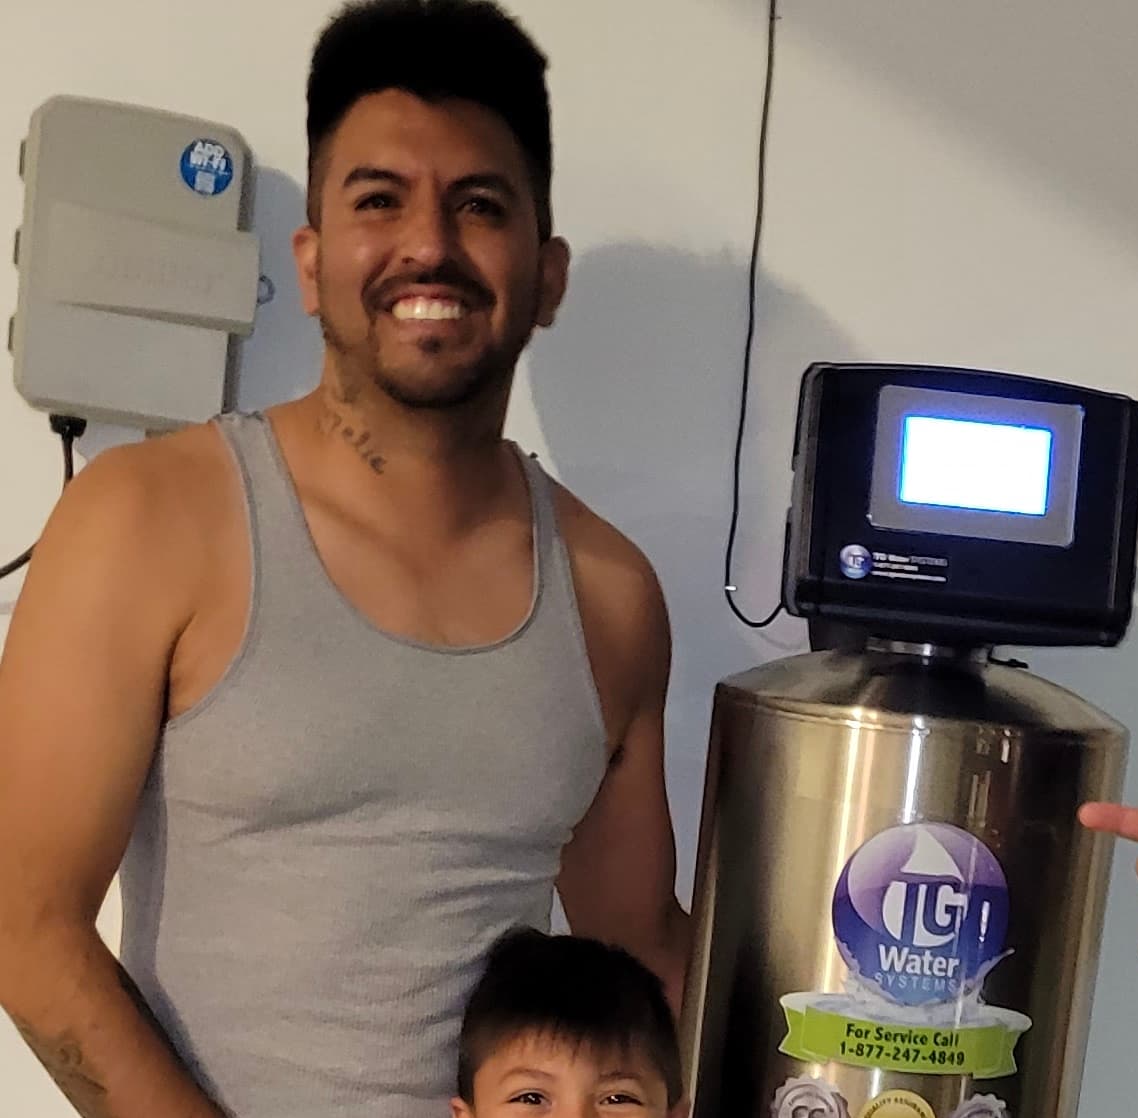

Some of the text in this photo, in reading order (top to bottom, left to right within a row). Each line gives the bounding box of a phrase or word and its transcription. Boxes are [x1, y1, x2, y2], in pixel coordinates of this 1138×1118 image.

[878, 944, 960, 978] Water
[874, 973, 961, 992] SYSTEMS
[846, 1023, 959, 1047] For Service Call
